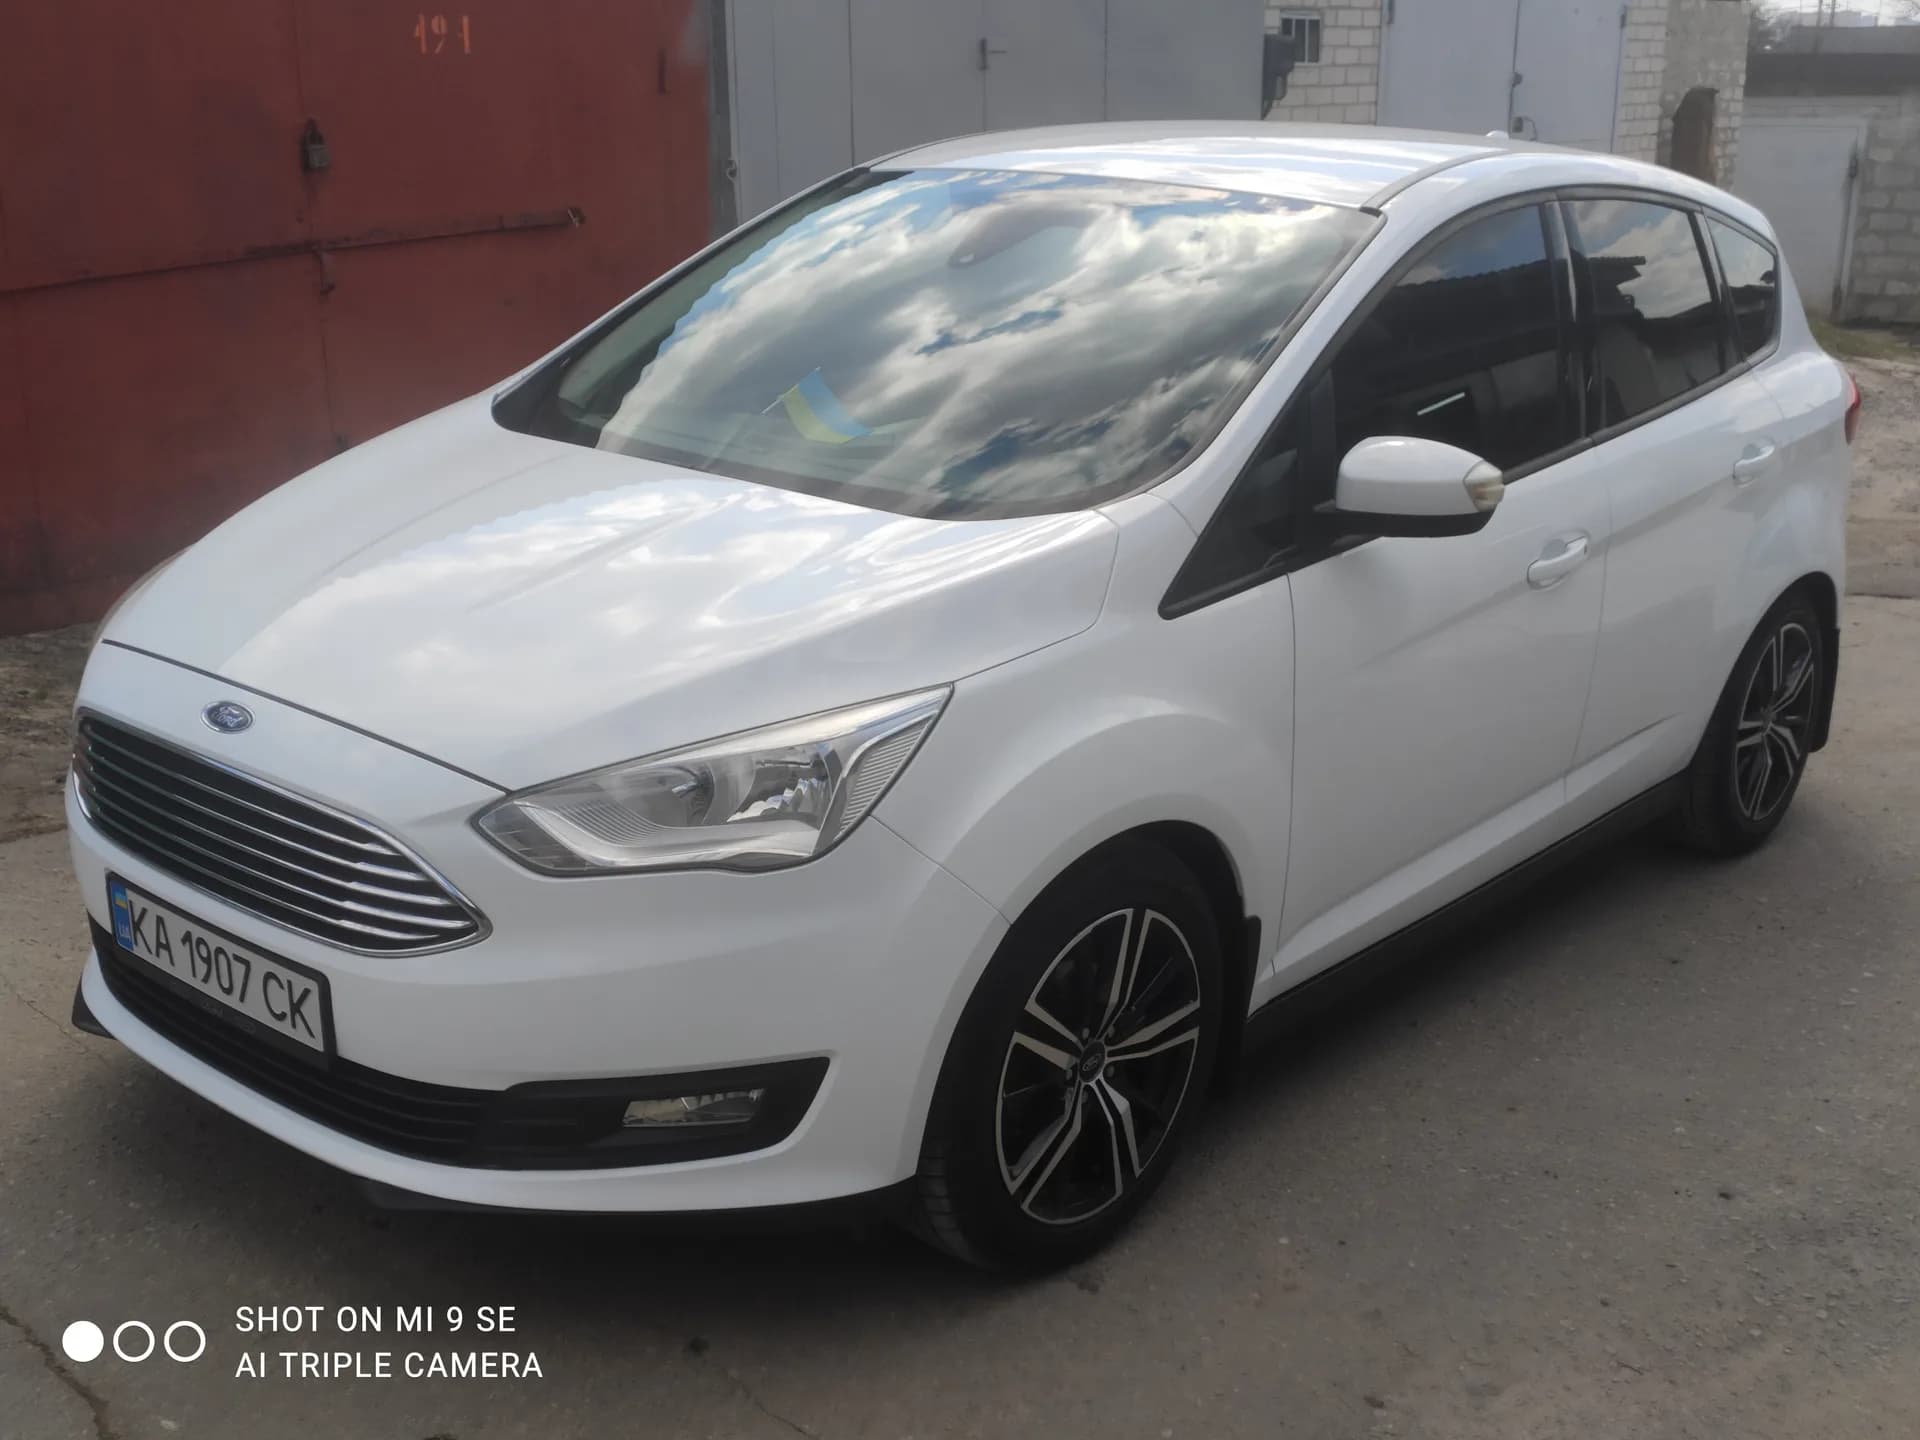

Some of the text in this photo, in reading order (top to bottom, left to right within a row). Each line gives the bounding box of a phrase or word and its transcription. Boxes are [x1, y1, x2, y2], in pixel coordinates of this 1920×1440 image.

[414, 14, 472, 55] 191
[211, 706, 243, 728] Ford
[128, 899, 175, 967] KA
[181, 930, 251, 1003] 1907
[262, 970, 316, 1039] CK
